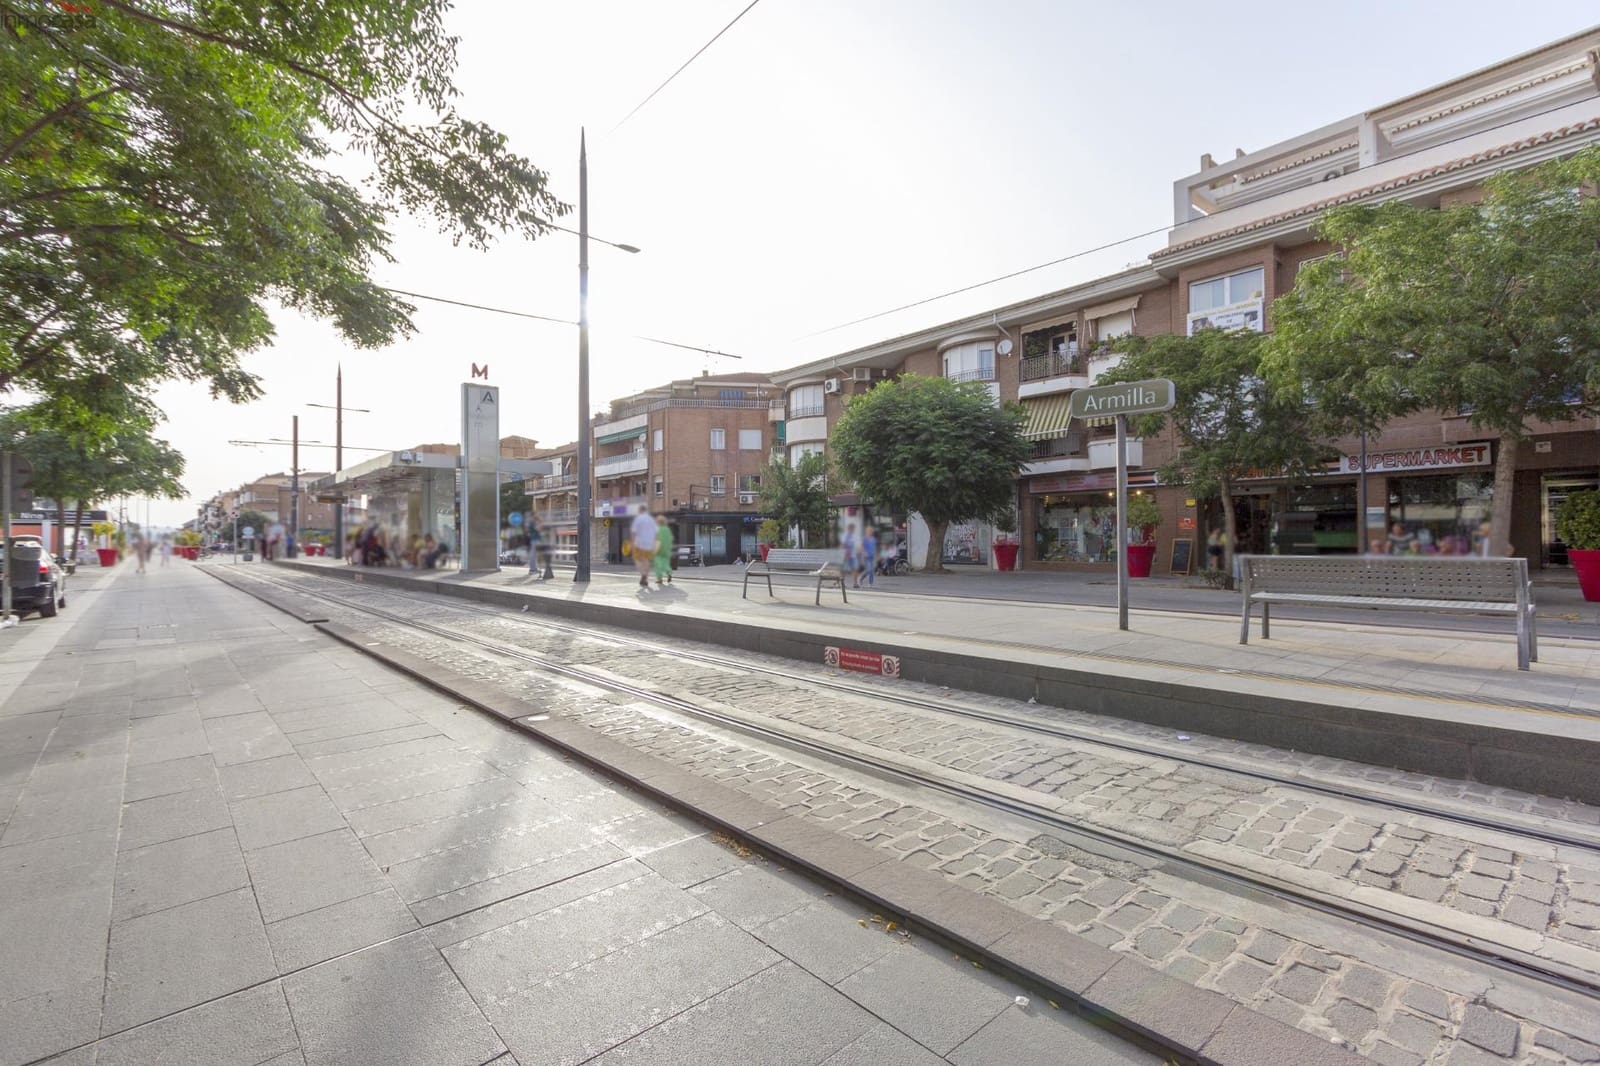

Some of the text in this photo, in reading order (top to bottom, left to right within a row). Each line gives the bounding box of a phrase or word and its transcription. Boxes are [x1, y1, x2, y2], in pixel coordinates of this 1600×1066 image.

[471, 362, 488, 380] M
[1083, 386, 1157, 412] Armilla
[1347, 445, 1488, 471] SUPERMARKET
